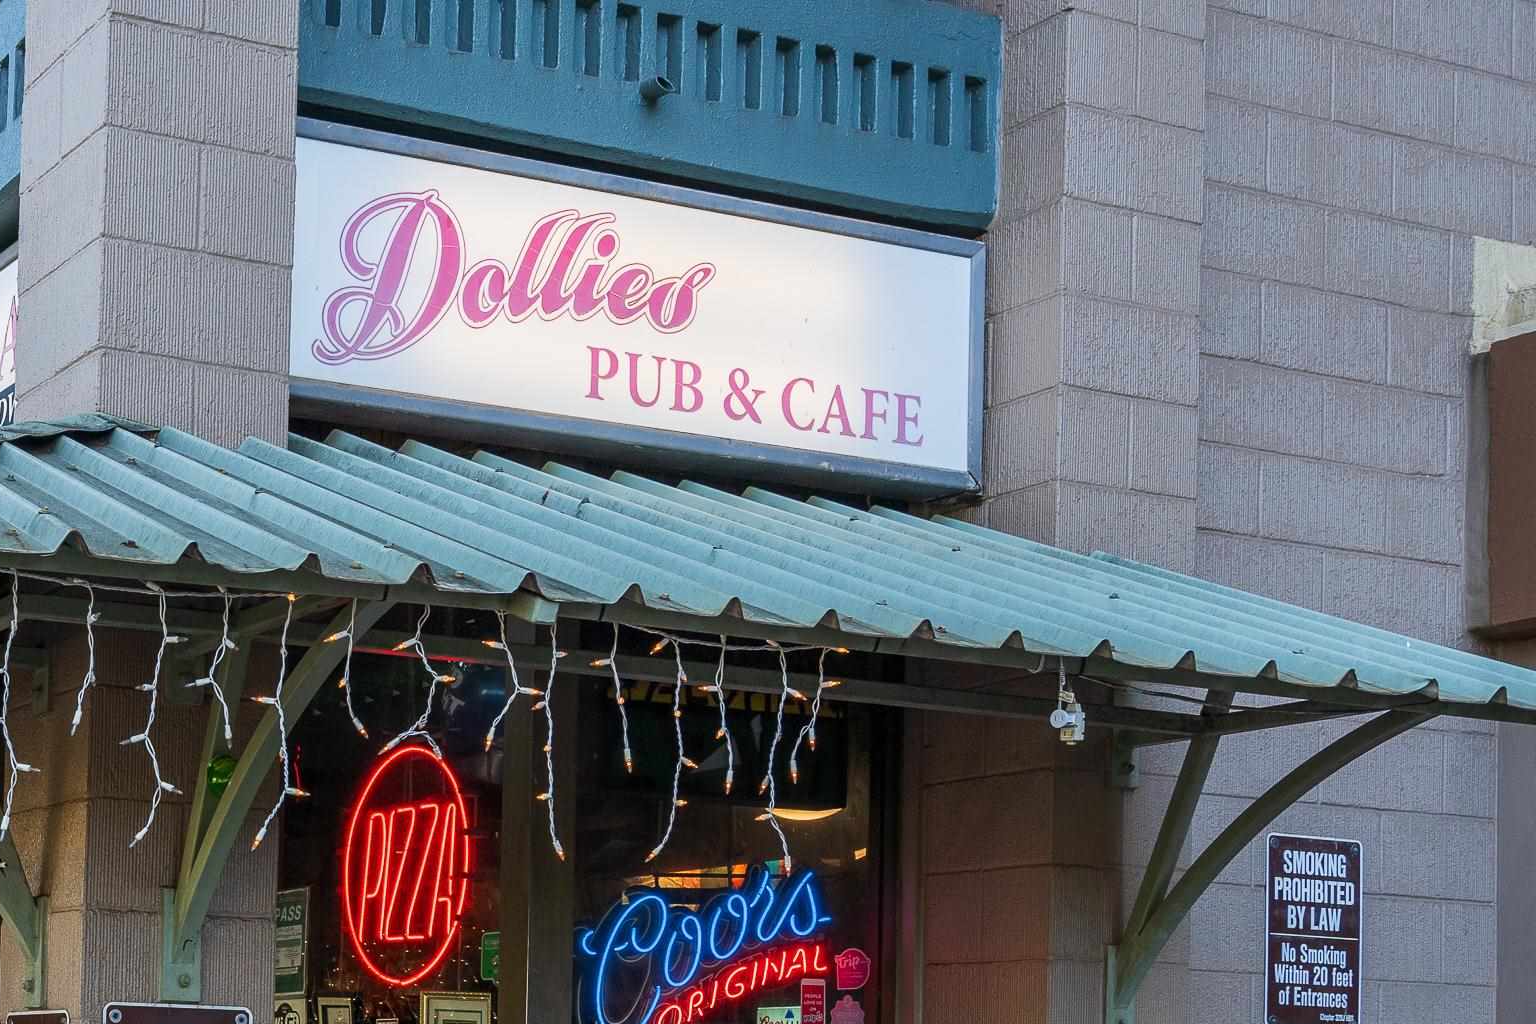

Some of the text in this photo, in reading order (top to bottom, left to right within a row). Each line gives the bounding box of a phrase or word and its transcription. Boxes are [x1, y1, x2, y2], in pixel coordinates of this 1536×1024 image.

[584, 345, 925, 447] PUB & CAFE
[359, 803, 457, 942] PIZZA
[1283, 850, 1347, 879] SMOKING
[1274, 877, 1354, 905] PROHIBITED
[1287, 905, 1342, 932] BY LAW
[1281, 942, 1346, 968] No Smoking
[1274, 964, 1353, 987] Within 20 feet
[1278, 986, 1348, 1009] of Entrances
